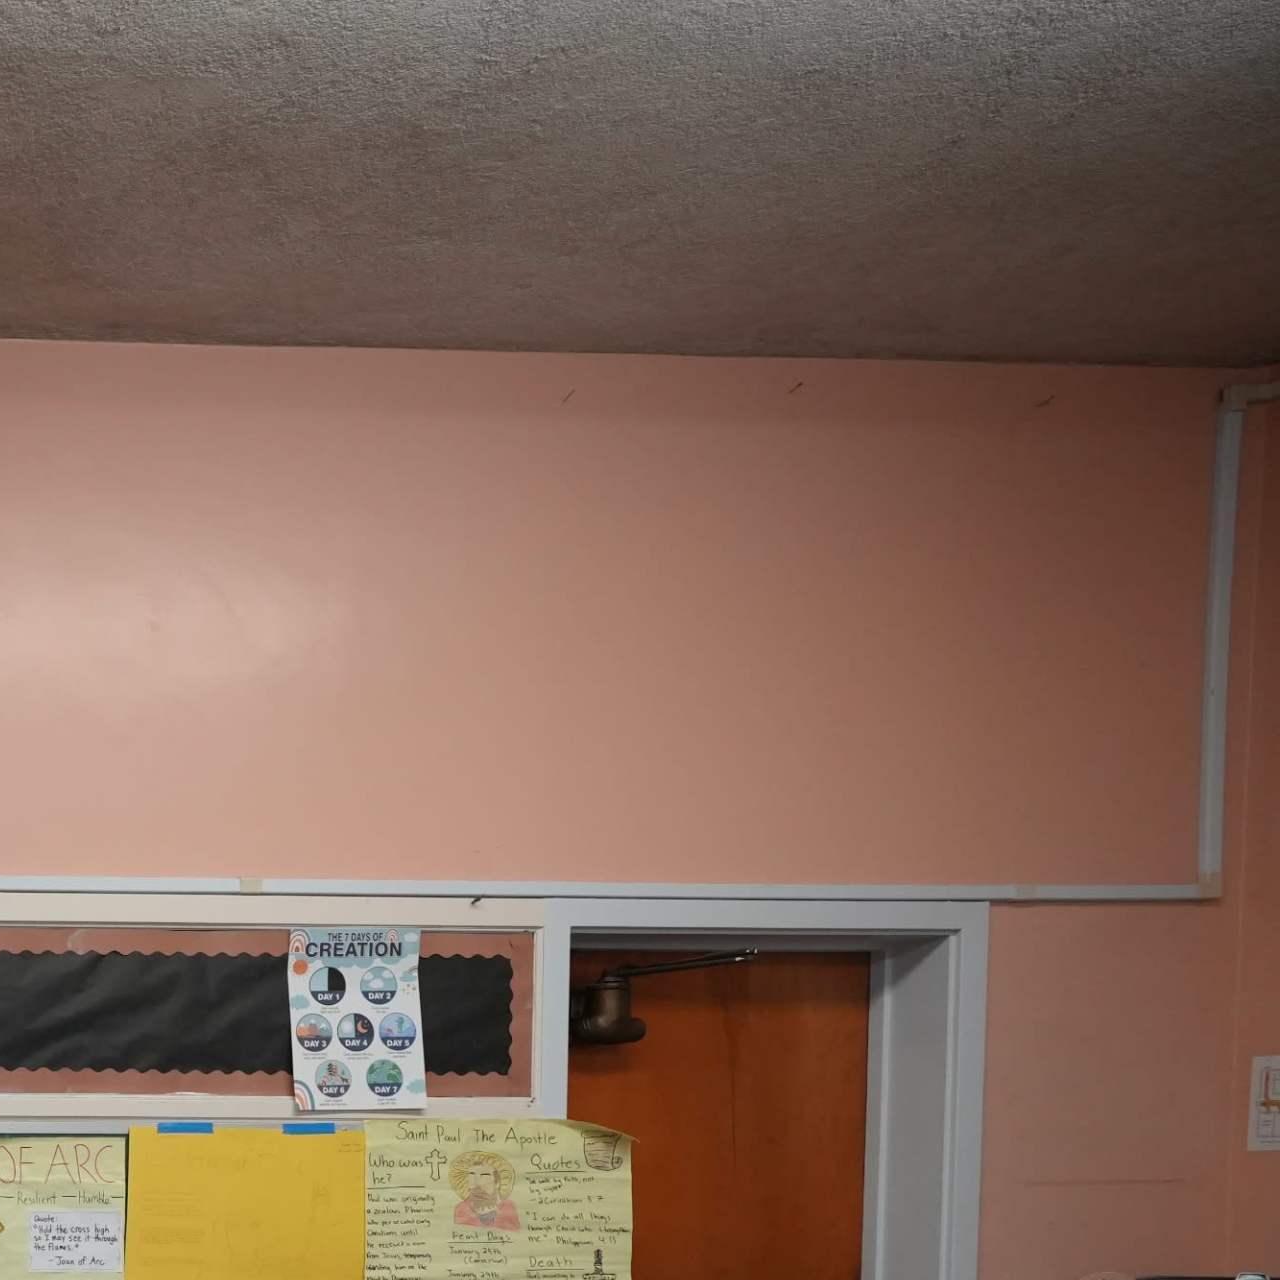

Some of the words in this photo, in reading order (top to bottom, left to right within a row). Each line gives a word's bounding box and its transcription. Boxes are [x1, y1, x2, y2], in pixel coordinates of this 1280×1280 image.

[328, 933, 343, 942] THE
[344, 933, 350, 942] 7
[351, 933, 371, 942] DAYS
[372, 932, 384, 942] OF
[305, 942, 403, 957] CREATION
[317, 993, 334, 1001] DAY
[336, 993, 341, 1001] 1
[368, 992, 384, 1000] DAY
[385, 992, 392, 1000] 2
[304, 1040, 320, 1048] DAY
[321, 1040, 327, 1048] 3
[344, 1039, 360, 1047] DAY
[362, 1039, 368, 1047] 4
[386, 1039, 403, 1048] DAY
[404, 1039, 410, 1048] 5
[322, 1087, 338, 1095] DAY
[339, 1087, 345, 1095] 6
[374, 1086, 391, 1094] DAY
[392, 1086, 398, 1094] 7
[395, 1121, 429, 1141] Saint
[436, 1125, 461, 1143] Paul
[473, 1128, 495, 1144] The
[504, 1127, 558, 1150] Apostle
[44, 1143, 115, 1185] ARC
[369, 1152, 395, 1168] Who
[398, 1160, 423, 1168] was
[531, 1153, 581, 1170] Quotes
[372, 1171, 392, 1185] he?
[17, 1191, 57, 1205] Resilient
[78, 1191, 111, 1205] Humble
[56, 1224, 67, 1234] the
[94, 1223, 110, 1235] high
[93, 1234, 118, 1245] through
[452, 1232, 478, 1240] Feast
[34, 1243, 46, 1252] the
[78, 1256, 87, 1265] of
[89, 1256, 105, 1265] Arc
[529, 1256, 573, 1267] Death
